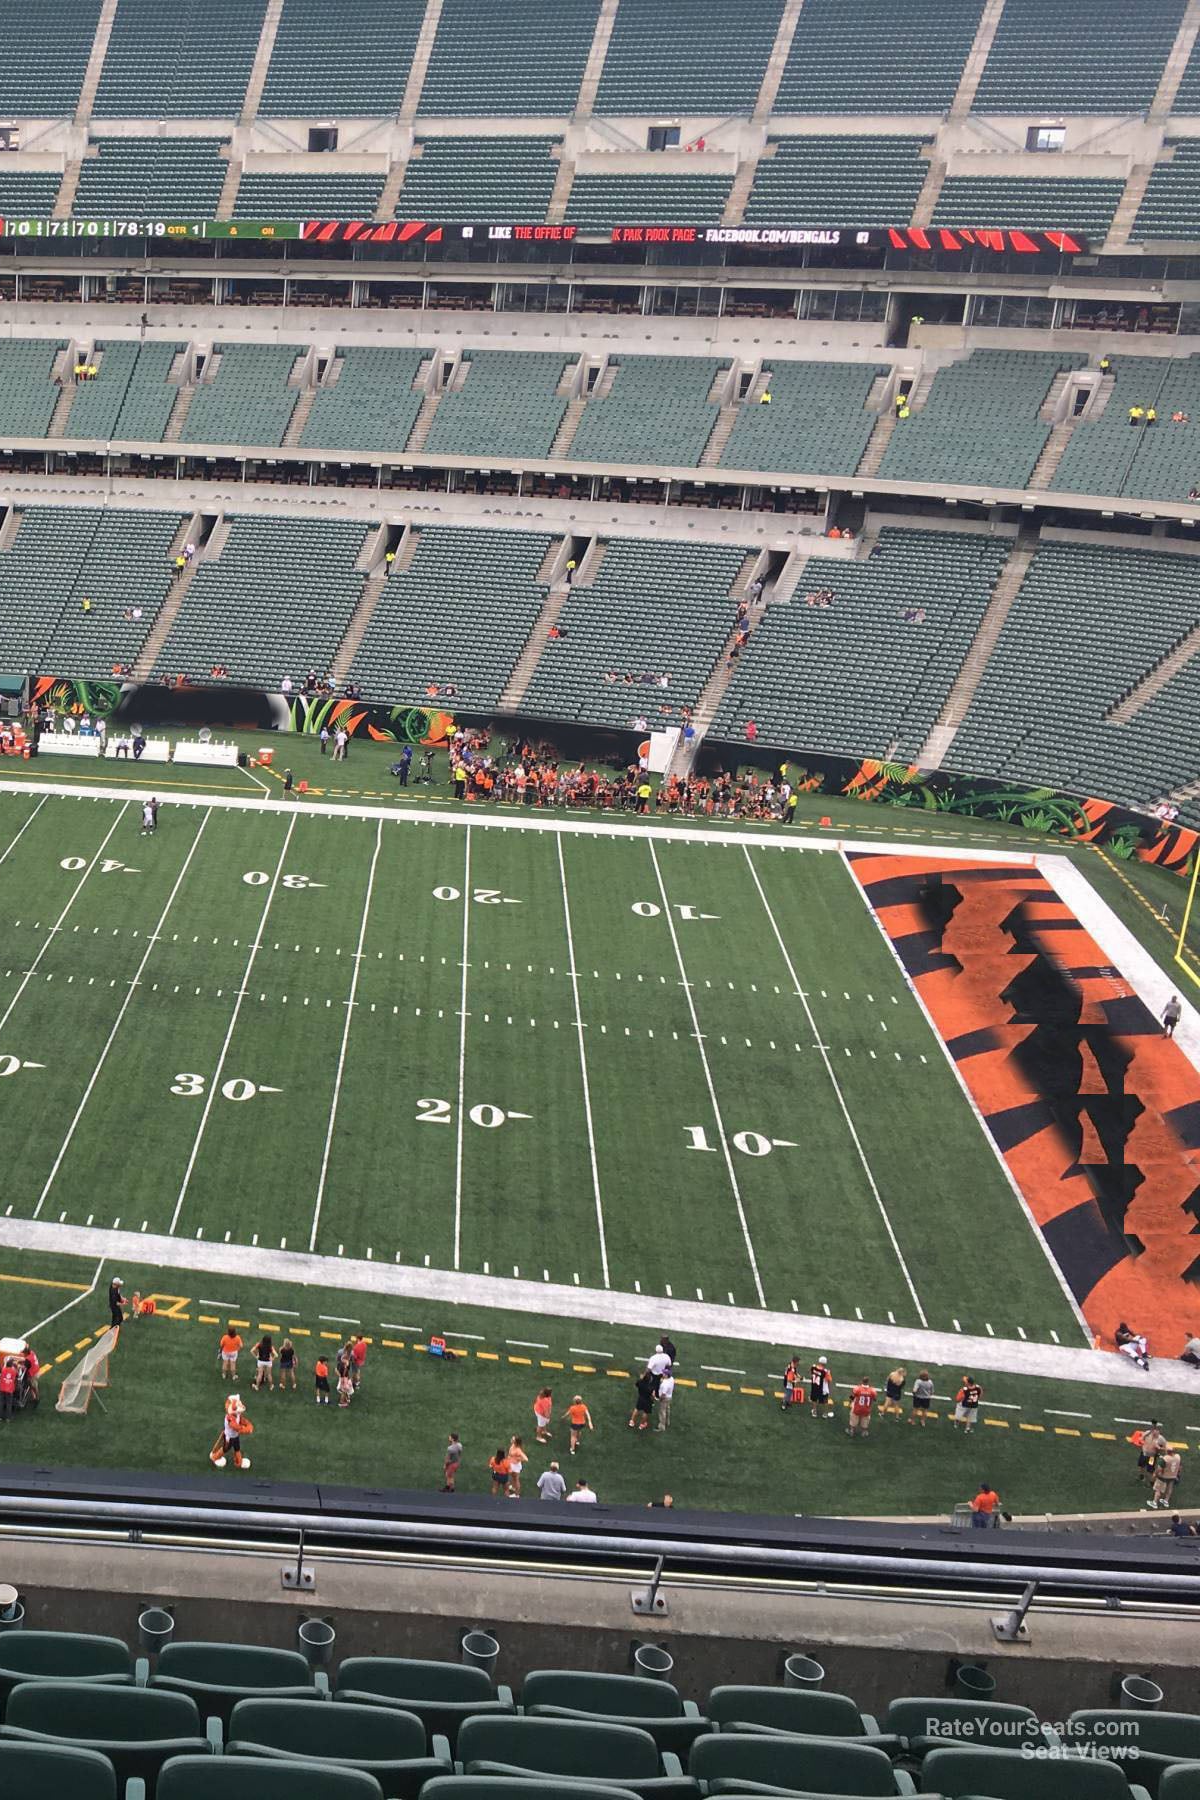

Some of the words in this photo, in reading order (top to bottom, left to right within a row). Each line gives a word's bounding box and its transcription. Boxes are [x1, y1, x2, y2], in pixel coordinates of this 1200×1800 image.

[117, 222, 165, 236] 78:19
[167, 226, 187, 234] QTR
[192, 224, 199, 235] 1
[488, 226, 512, 239] LIKE
[514, 226, 533, 239] THE
[705, 229, 840, 244] FACEBOOK.COM/BENGALS
[60, 856, 126, 872] 40
[242, 871, 309, 888] 30
[432, 886, 501, 904] 20
[631, 901, 699, 920] 10
[169, 1073, 256, 1101] 30
[415, 1098, 505, 1128] 20
[682, 1126, 772, 1156] 10
[858, 1396, 870, 1407] 81
